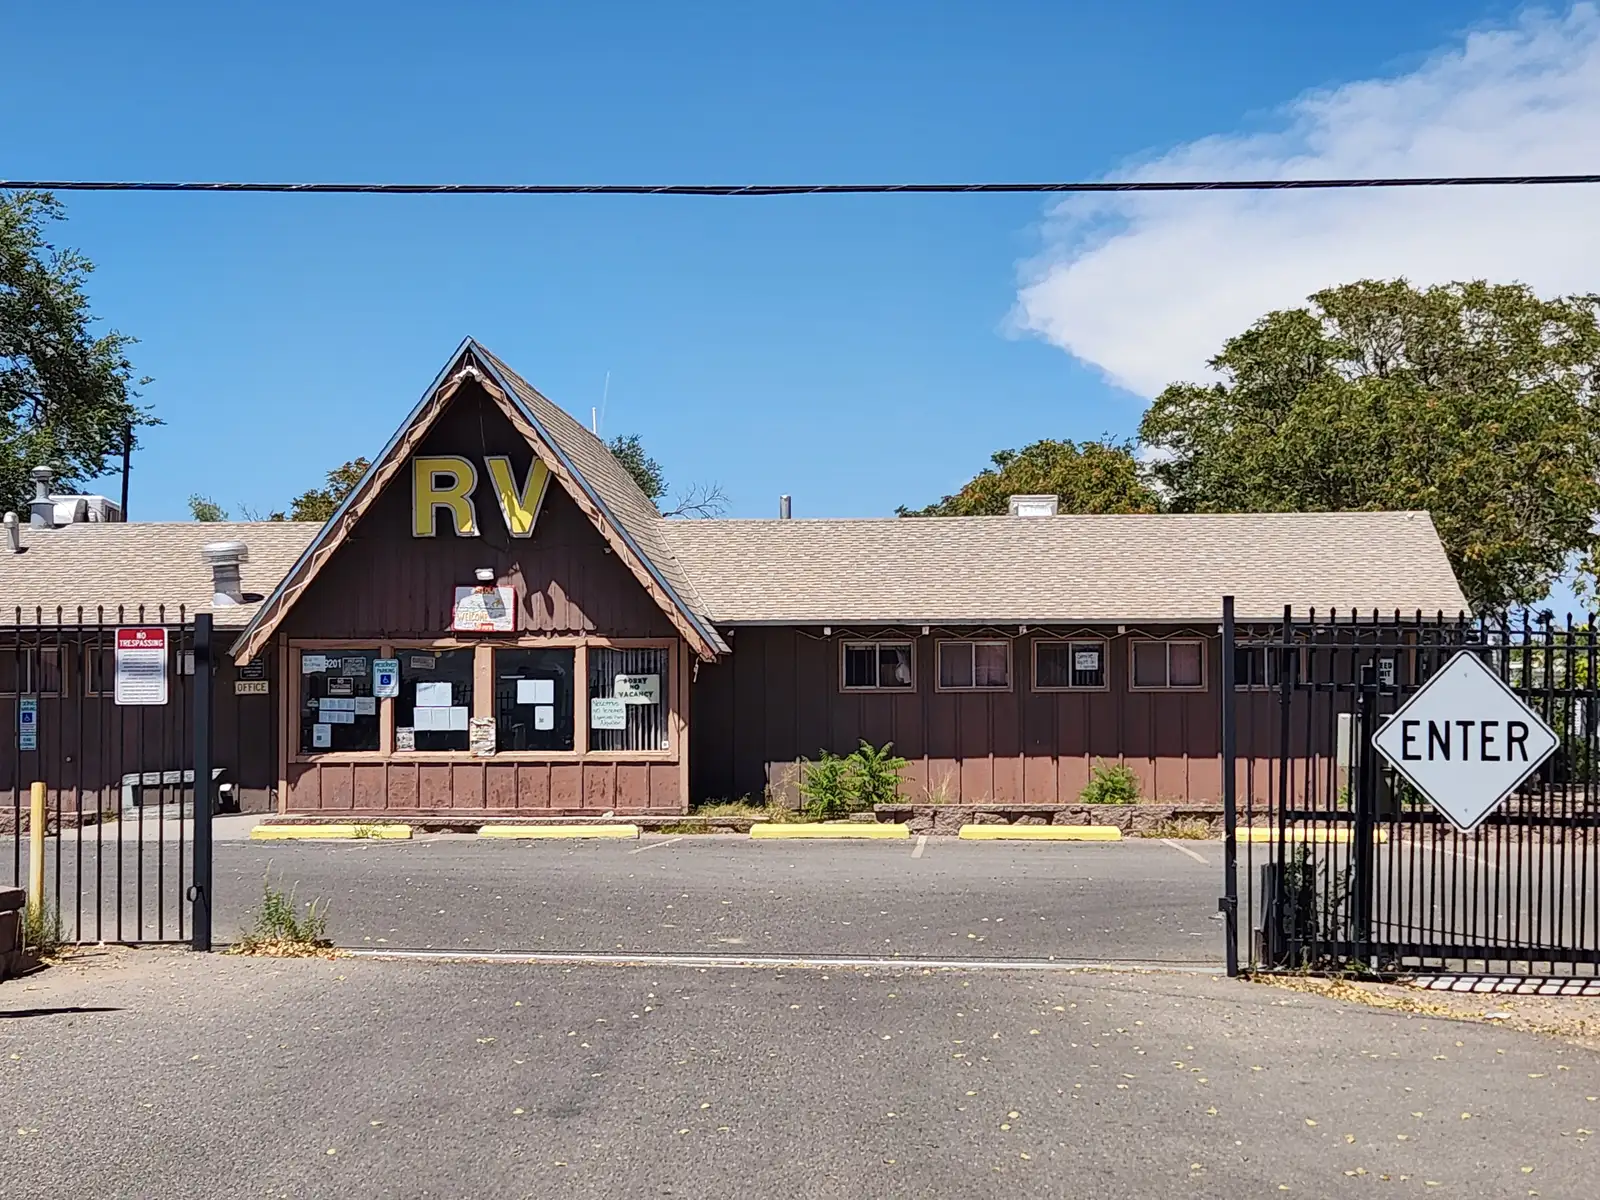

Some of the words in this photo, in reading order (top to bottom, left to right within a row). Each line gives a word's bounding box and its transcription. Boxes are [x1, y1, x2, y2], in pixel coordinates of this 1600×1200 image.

[412, 455, 551, 538] RV
[136, 632, 147, 640] NO
[119, 639, 164, 647] TRESPASSING
[237, 682, 266, 692] OFFICE
[1402, 720, 1529, 762] ENTER
